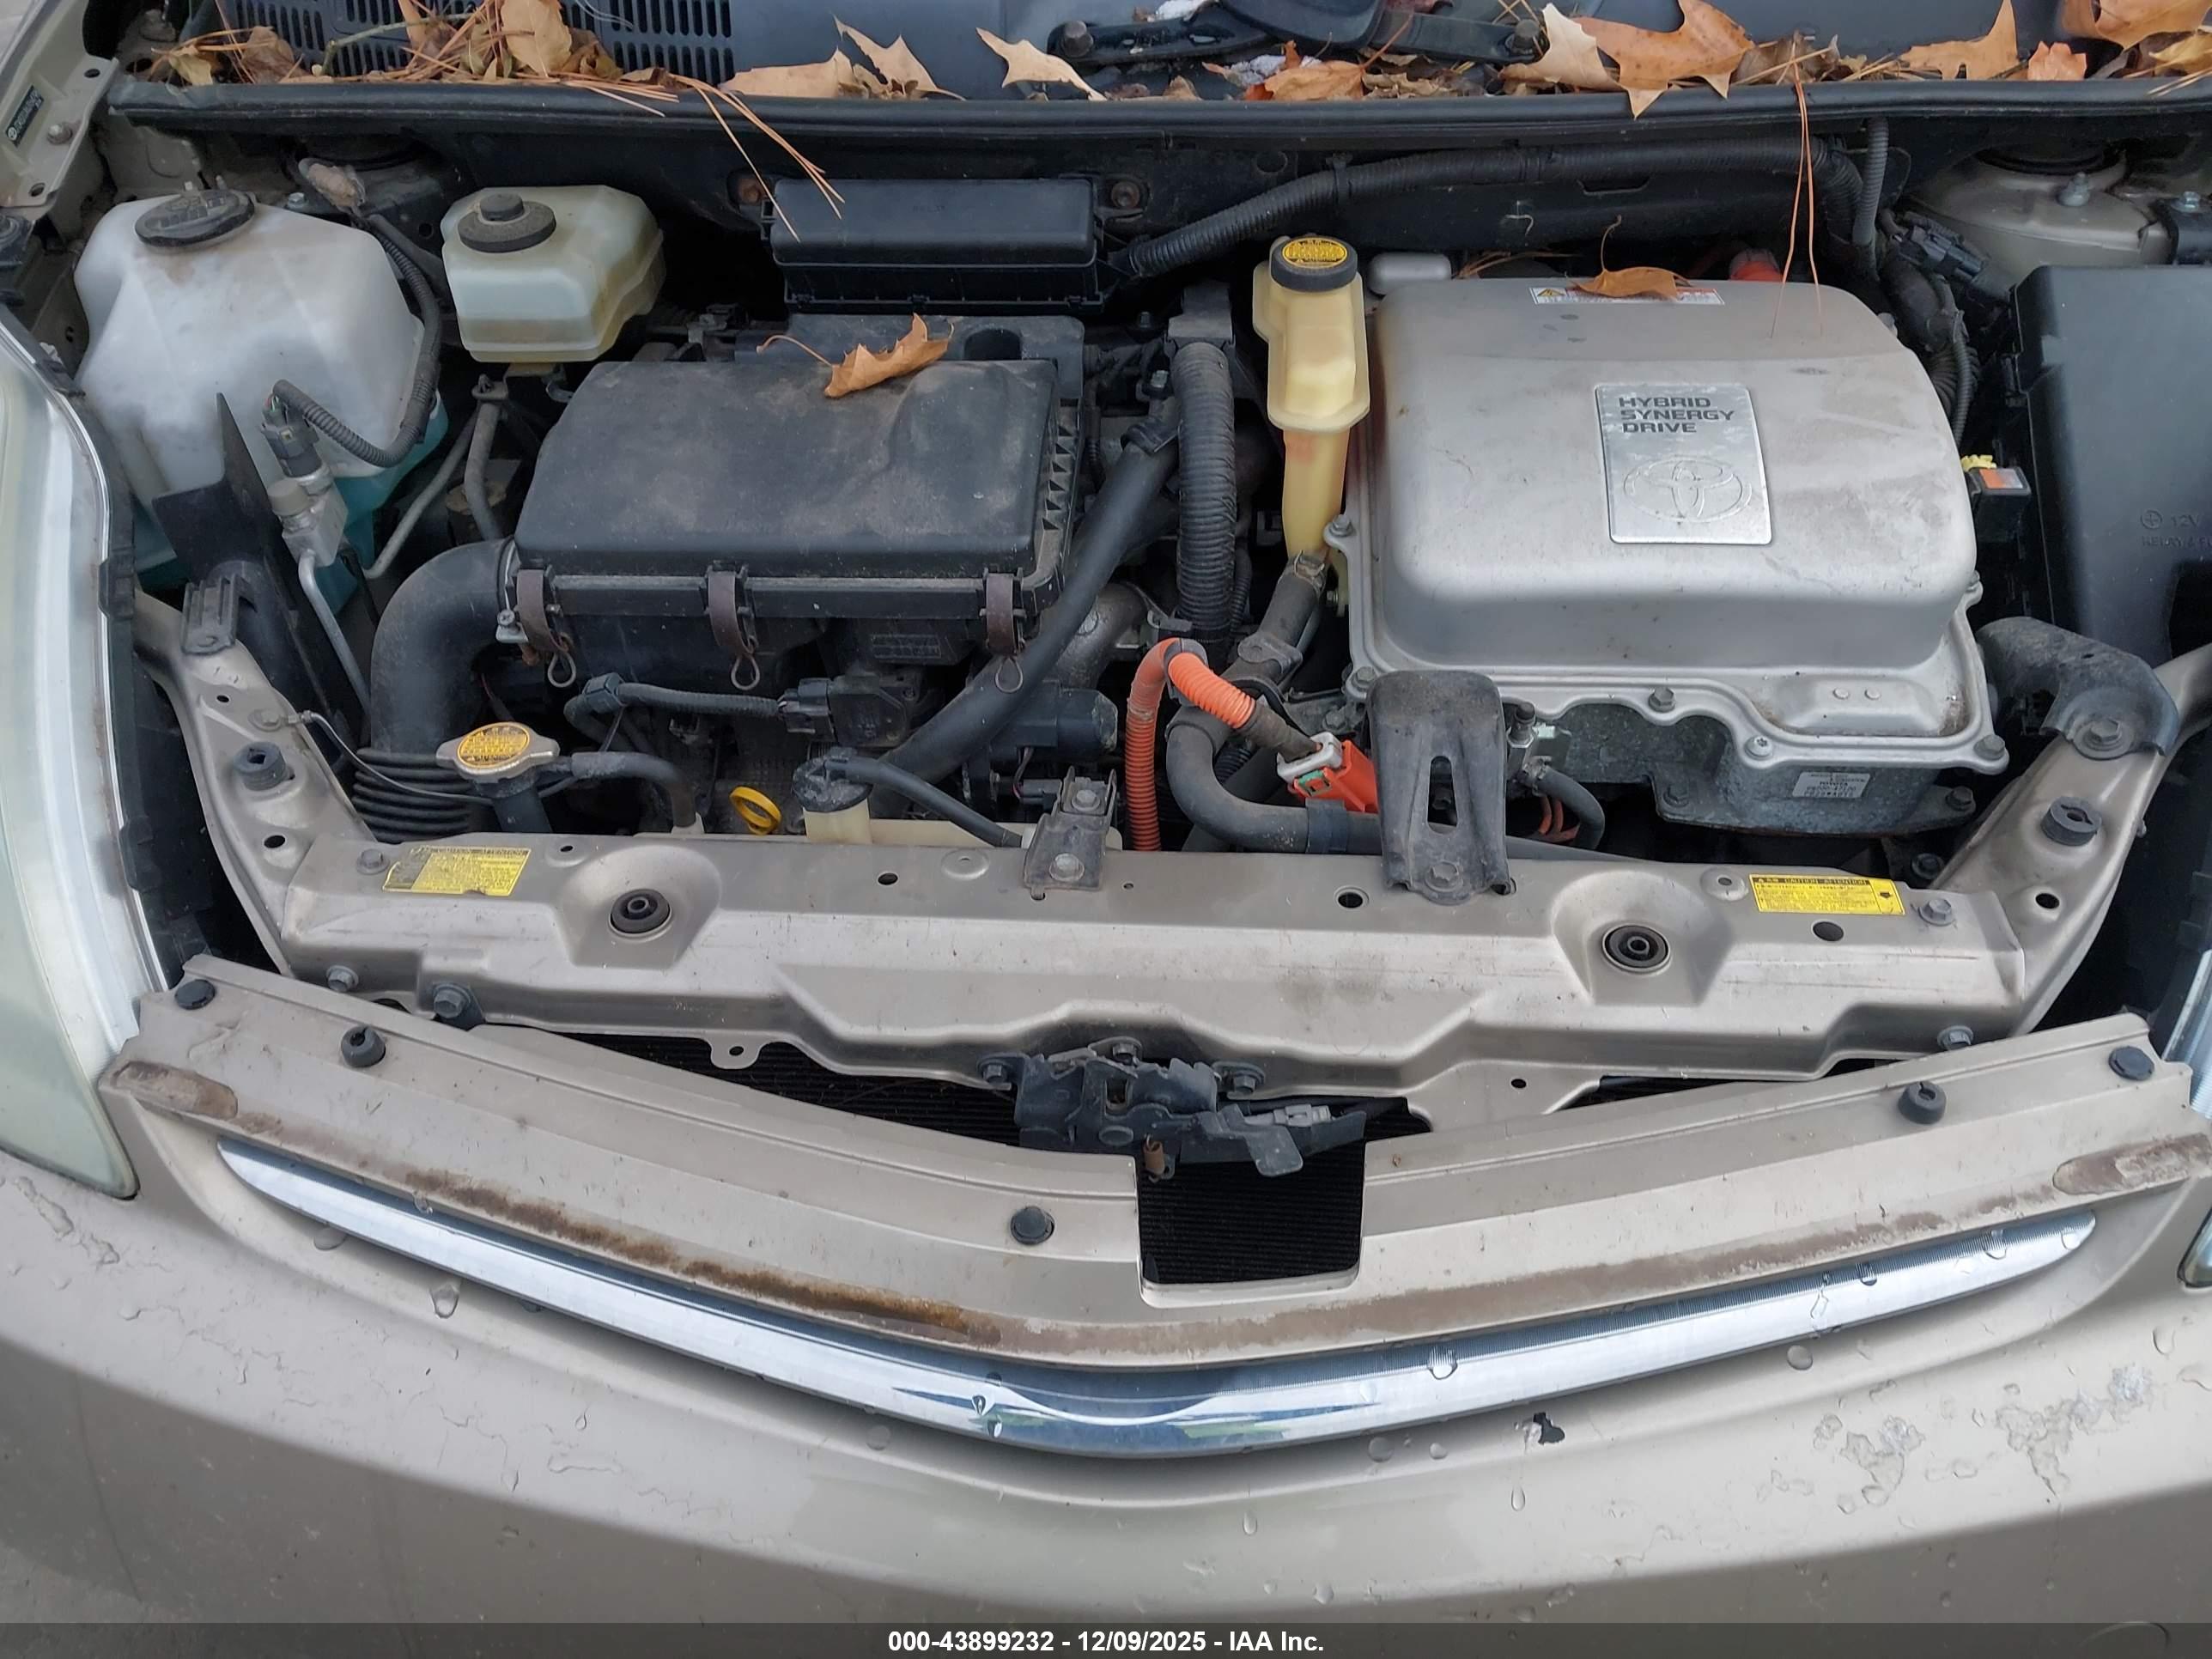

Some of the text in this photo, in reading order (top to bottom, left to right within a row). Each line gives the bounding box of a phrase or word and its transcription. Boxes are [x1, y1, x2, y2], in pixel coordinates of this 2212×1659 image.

[1619, 397, 1711, 408] HYBRID
[1620, 410, 1735, 421] SYNERGY
[1623, 422, 1698, 433] DRIVE
